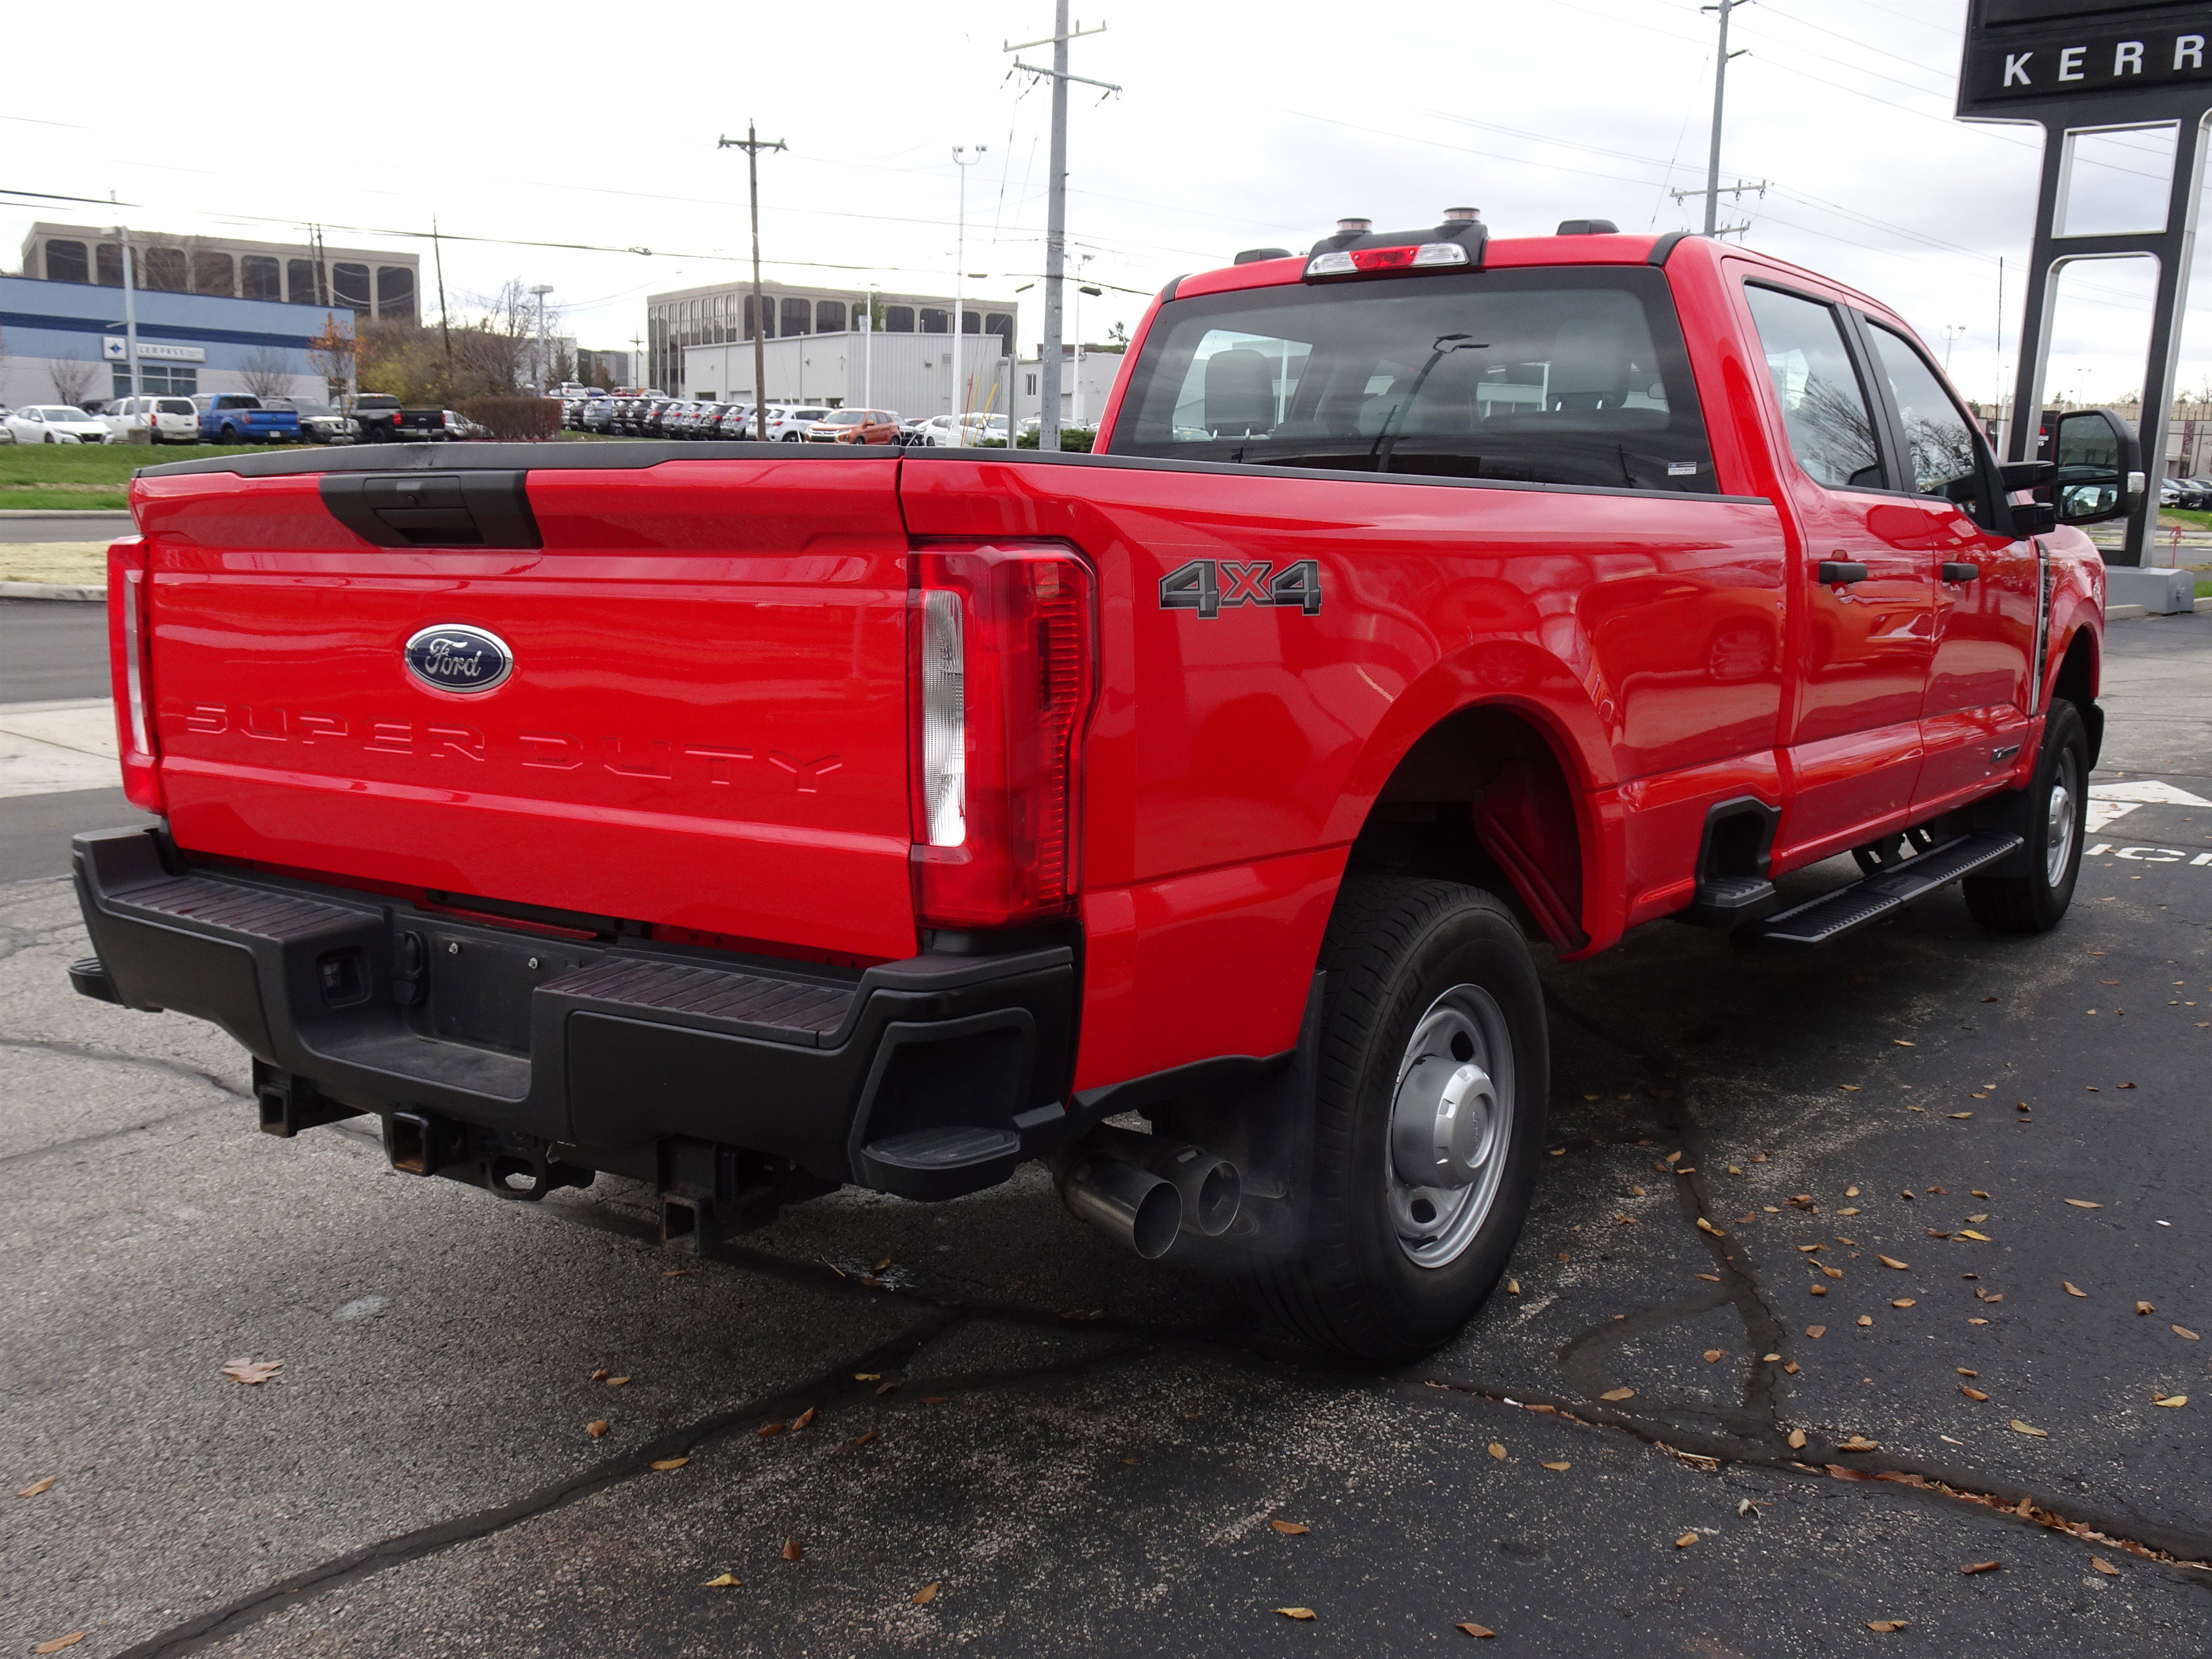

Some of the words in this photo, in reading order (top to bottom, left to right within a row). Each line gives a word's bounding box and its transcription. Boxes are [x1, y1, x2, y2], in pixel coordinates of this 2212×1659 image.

[2004, 34, 2205, 87] KERR
[425, 638, 483, 677] Ford
[186, 703, 485, 762] SUPER
[519, 730, 842, 793] DUTY
